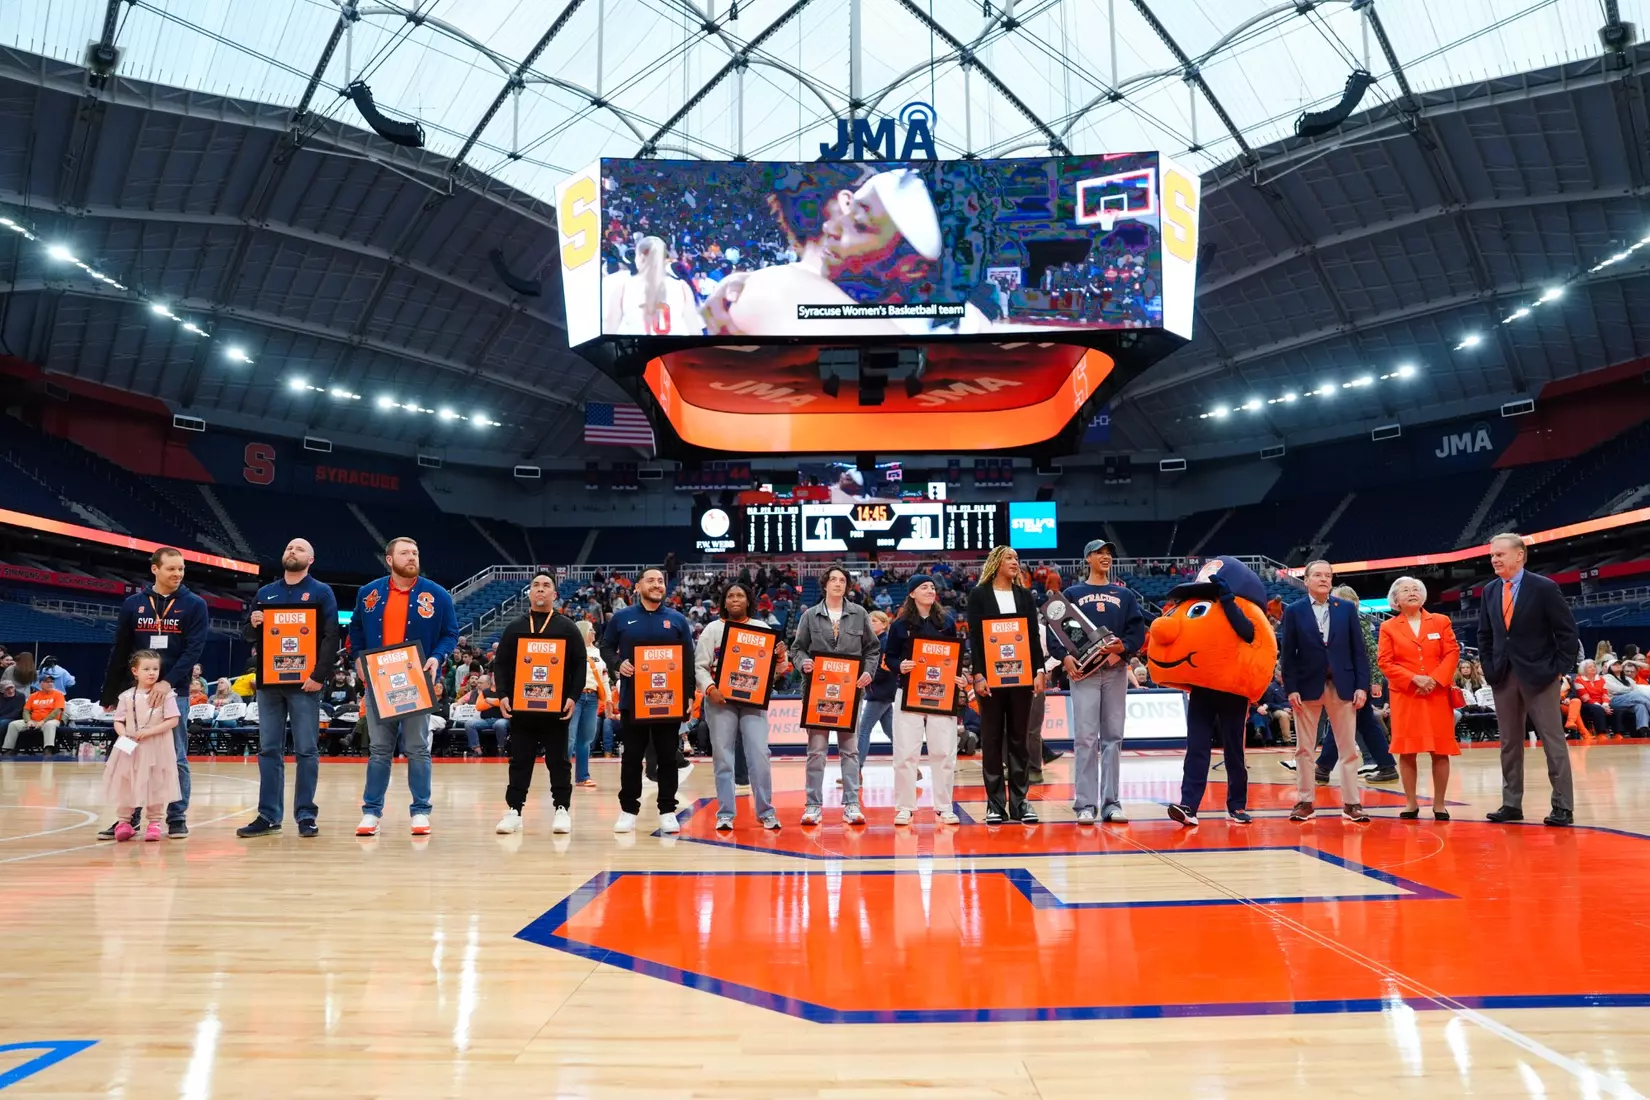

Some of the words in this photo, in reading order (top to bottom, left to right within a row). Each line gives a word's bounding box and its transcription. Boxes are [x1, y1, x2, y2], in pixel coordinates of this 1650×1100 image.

[820, 117, 938, 160] JMA
[798, 305, 841, 318] Syracuse
[842, 305, 887, 316] Women's
[888, 304, 937, 316] Basketball
[938, 304, 964, 315] team
[709, 377, 818, 408] JMA
[1435, 429, 1493, 458] JMA
[243, 442, 276, 485] S
[315, 465, 399, 491] SYRACUSE
[857, 505, 887, 521] 14:45
[814, 518, 832, 539] 41
[910, 516, 931, 538] 30
[1078, 594, 1121, 608] SYRACUSE
